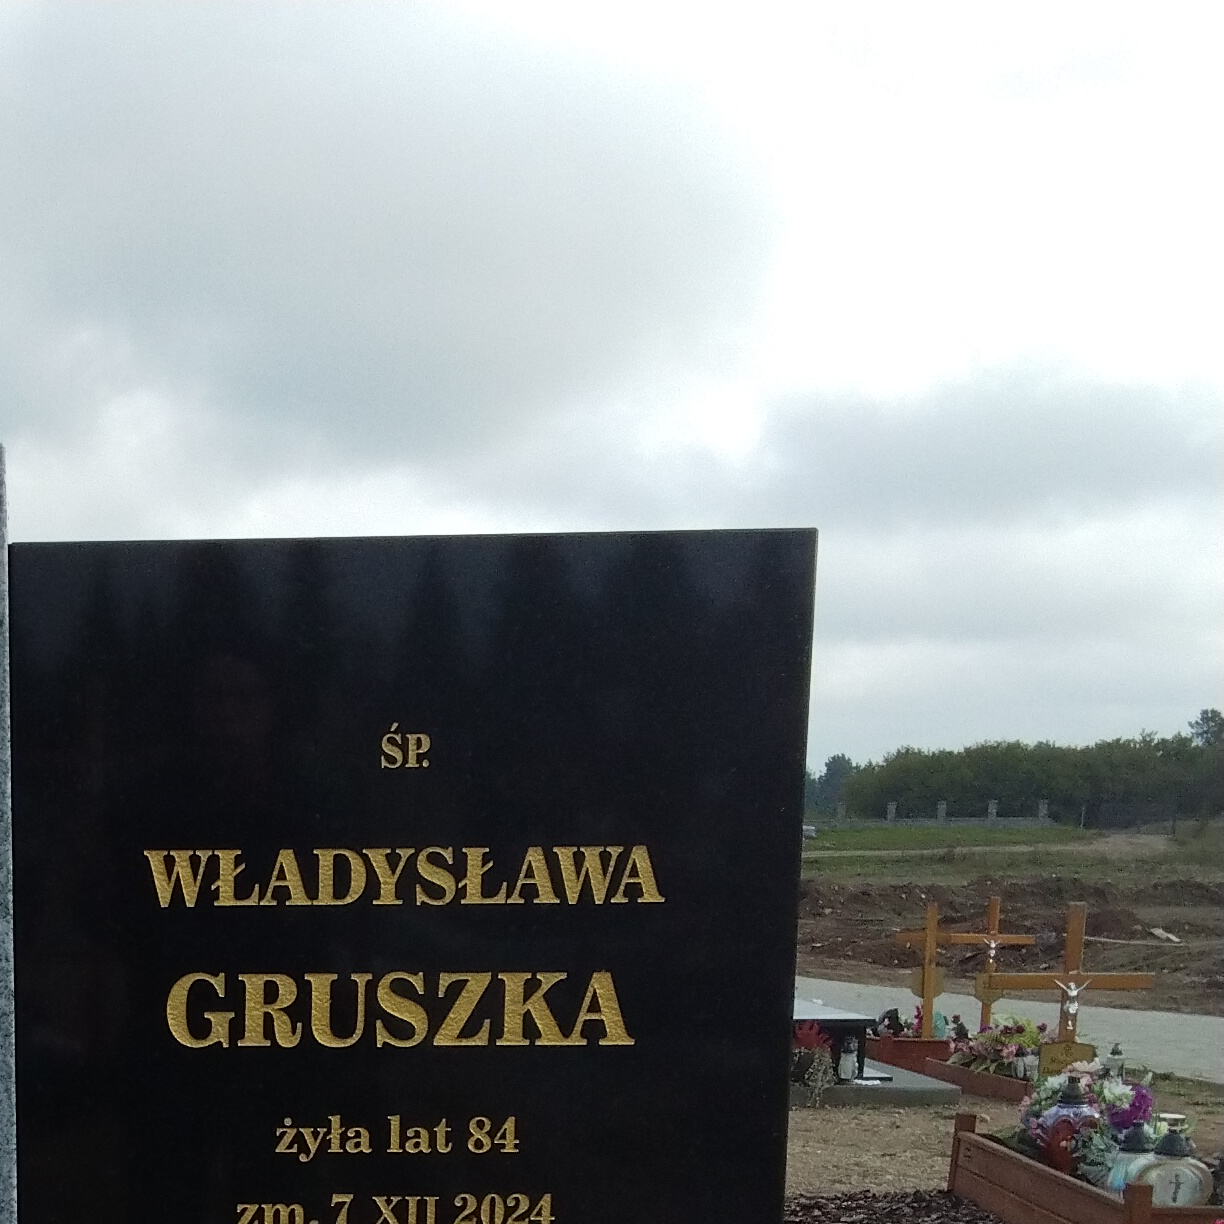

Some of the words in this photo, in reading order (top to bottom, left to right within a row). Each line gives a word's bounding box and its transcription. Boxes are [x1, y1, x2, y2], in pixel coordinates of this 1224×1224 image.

[144, 845, 665, 907] WŁADYSŁAWA
[166, 971, 635, 1048] GRUSZKA
[275, 1115, 373, 1162] żyła
[387, 1115, 453, 1154] lat
[467, 1116, 520, 1154] 84
